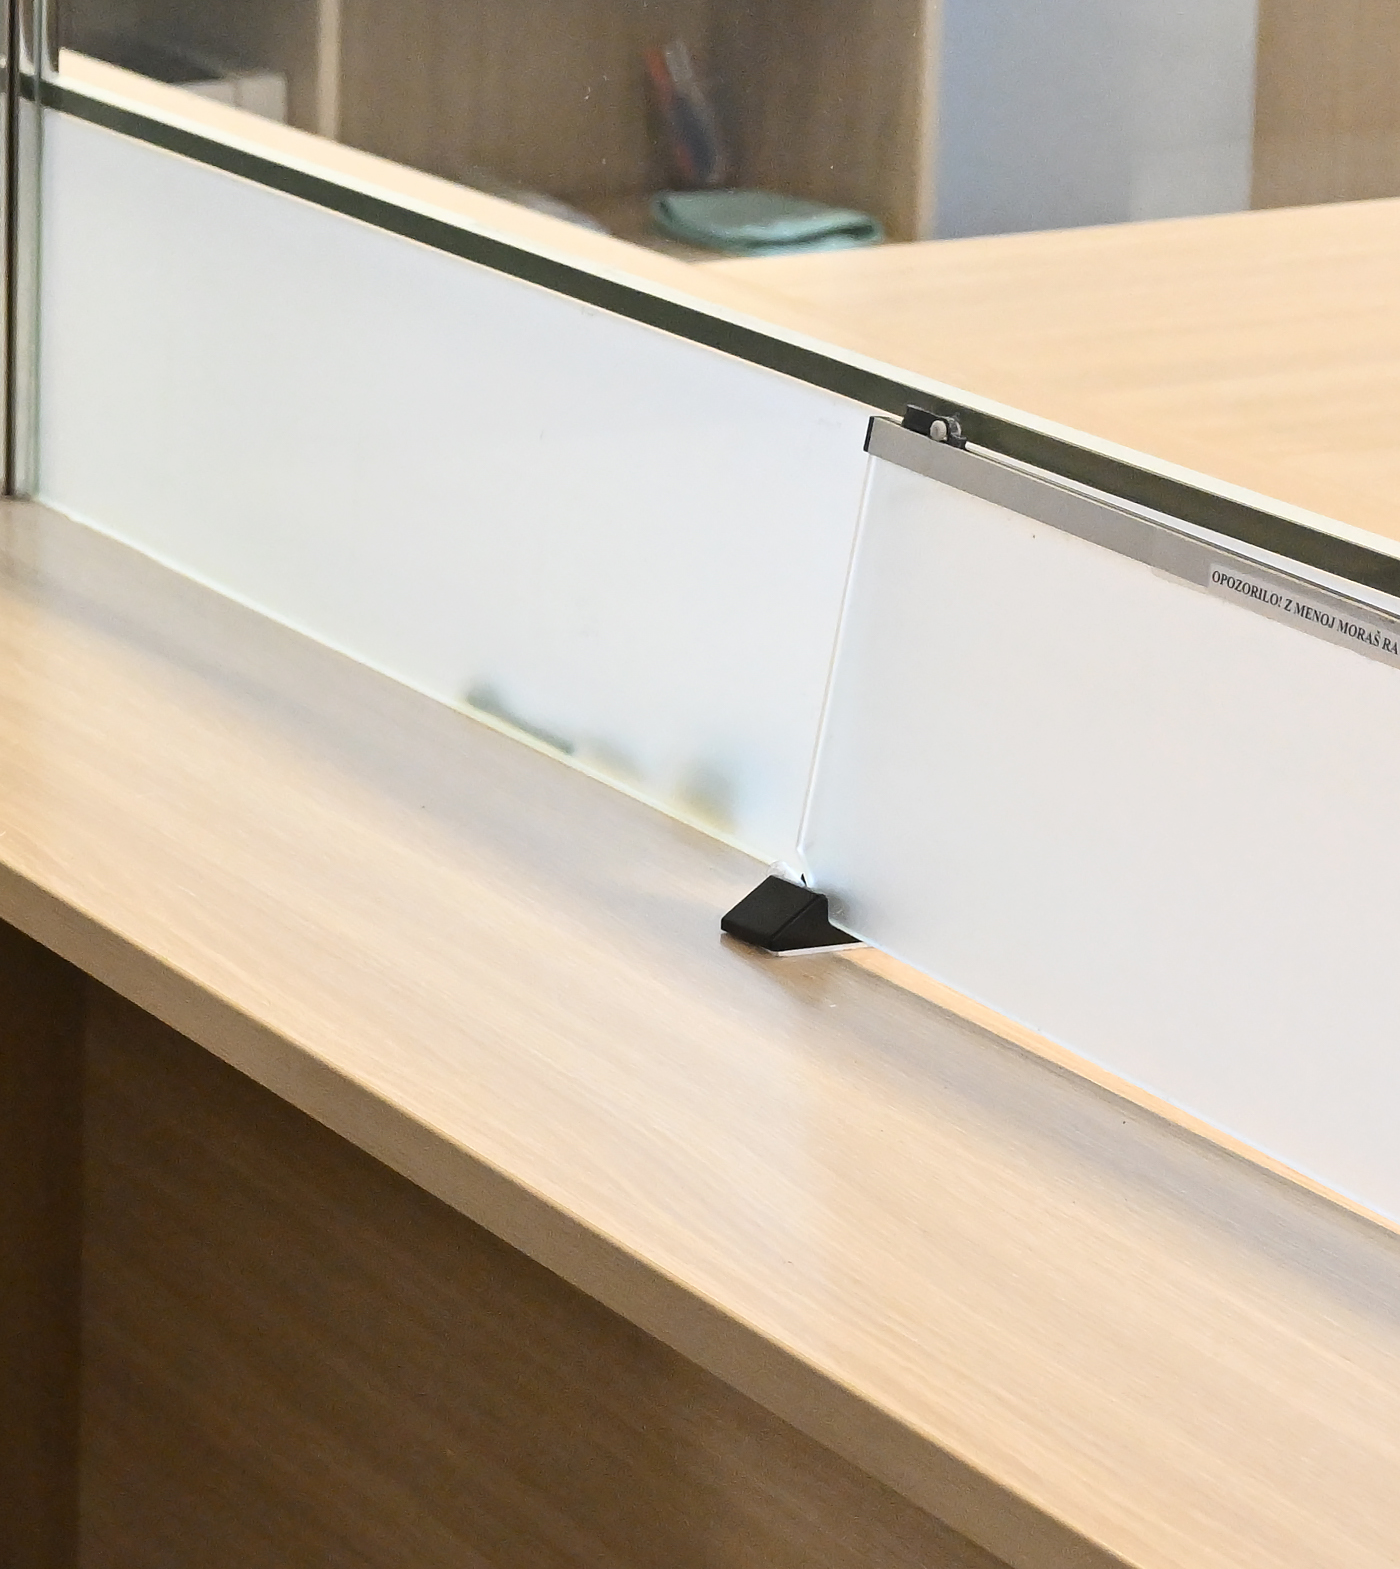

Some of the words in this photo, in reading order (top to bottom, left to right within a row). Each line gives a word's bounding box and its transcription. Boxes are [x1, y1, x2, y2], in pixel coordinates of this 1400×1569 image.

[1212, 570, 1283, 607] OPOZORILO!
[1283, 598, 1293, 612] Z
[1293, 602, 1335, 629] MENOJ
[1337, 619, 1381, 648] MORAŠ
